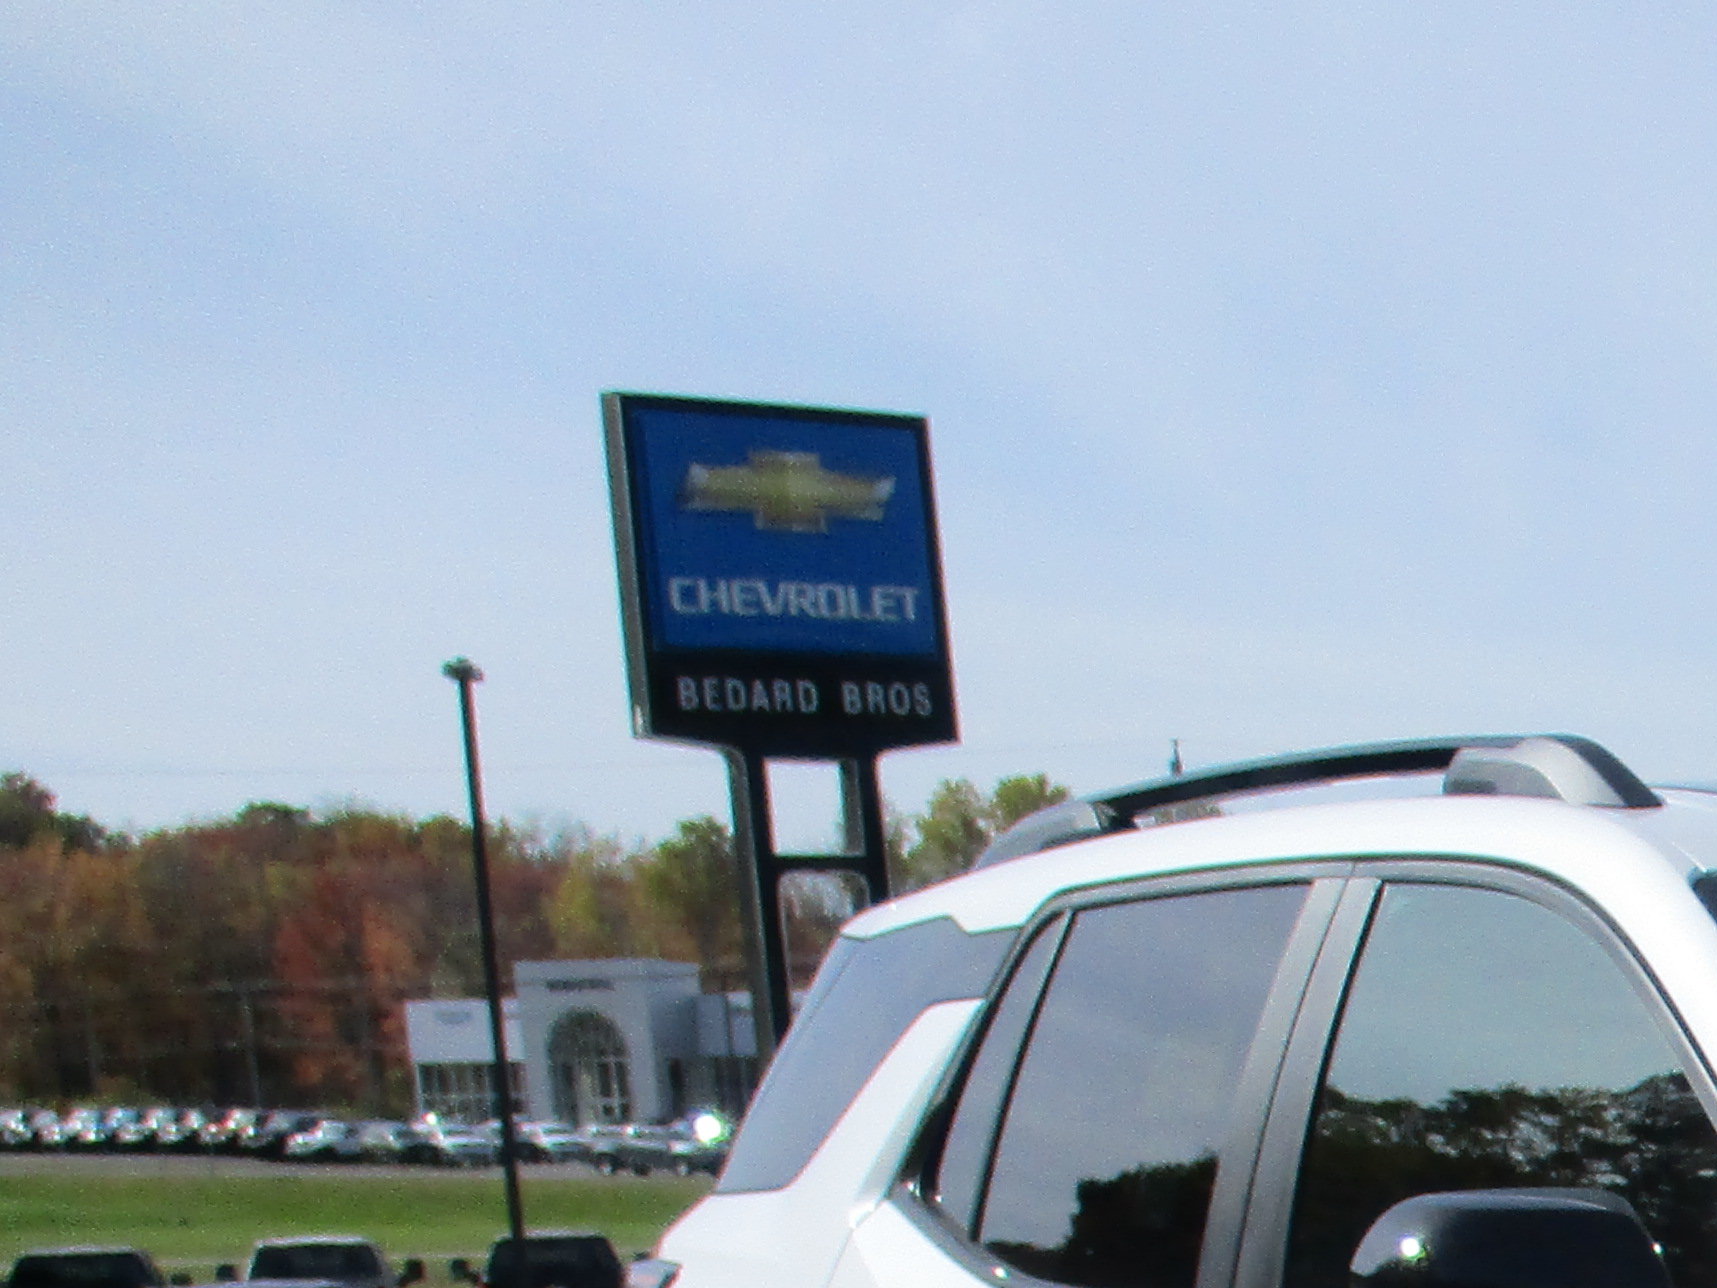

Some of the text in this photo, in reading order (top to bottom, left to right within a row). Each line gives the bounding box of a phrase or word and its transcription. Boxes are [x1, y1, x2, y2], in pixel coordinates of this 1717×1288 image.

[668, 576, 919, 622] CHEVROLET
[677, 675, 933, 717] BEDARD BROS
